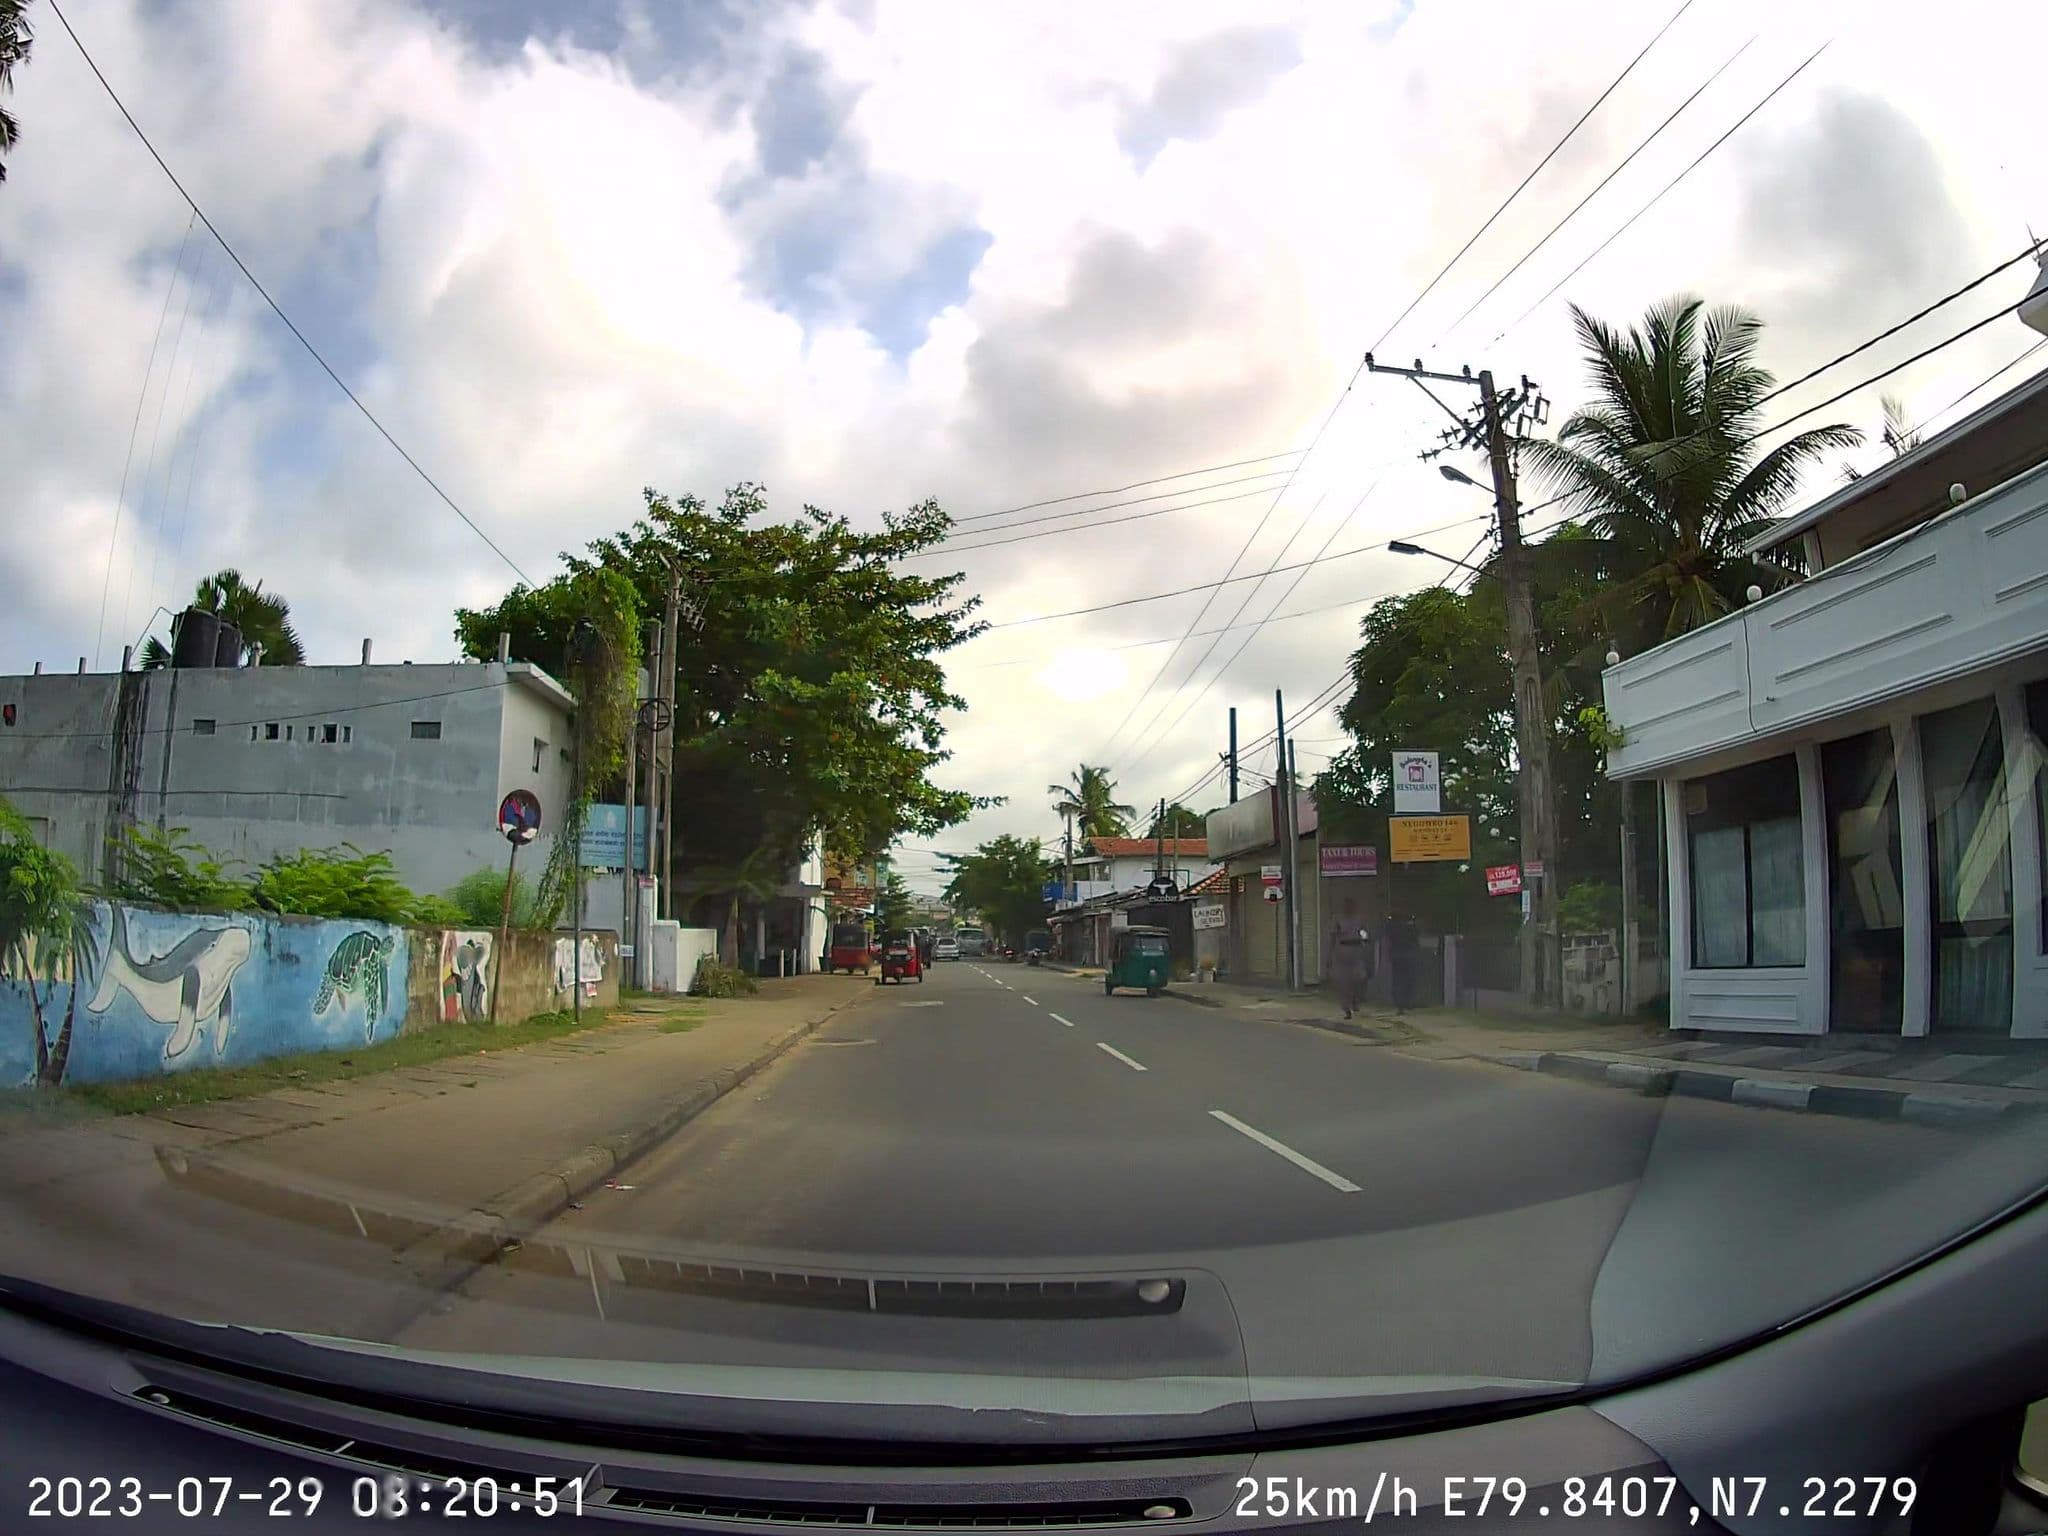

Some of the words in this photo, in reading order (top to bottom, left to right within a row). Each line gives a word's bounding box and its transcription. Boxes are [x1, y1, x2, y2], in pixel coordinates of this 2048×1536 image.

[1396, 783, 1437, 791] RESTAURANT
[1321, 848, 1340, 856] TAXI
[1350, 847, 1377, 856] TOURS
